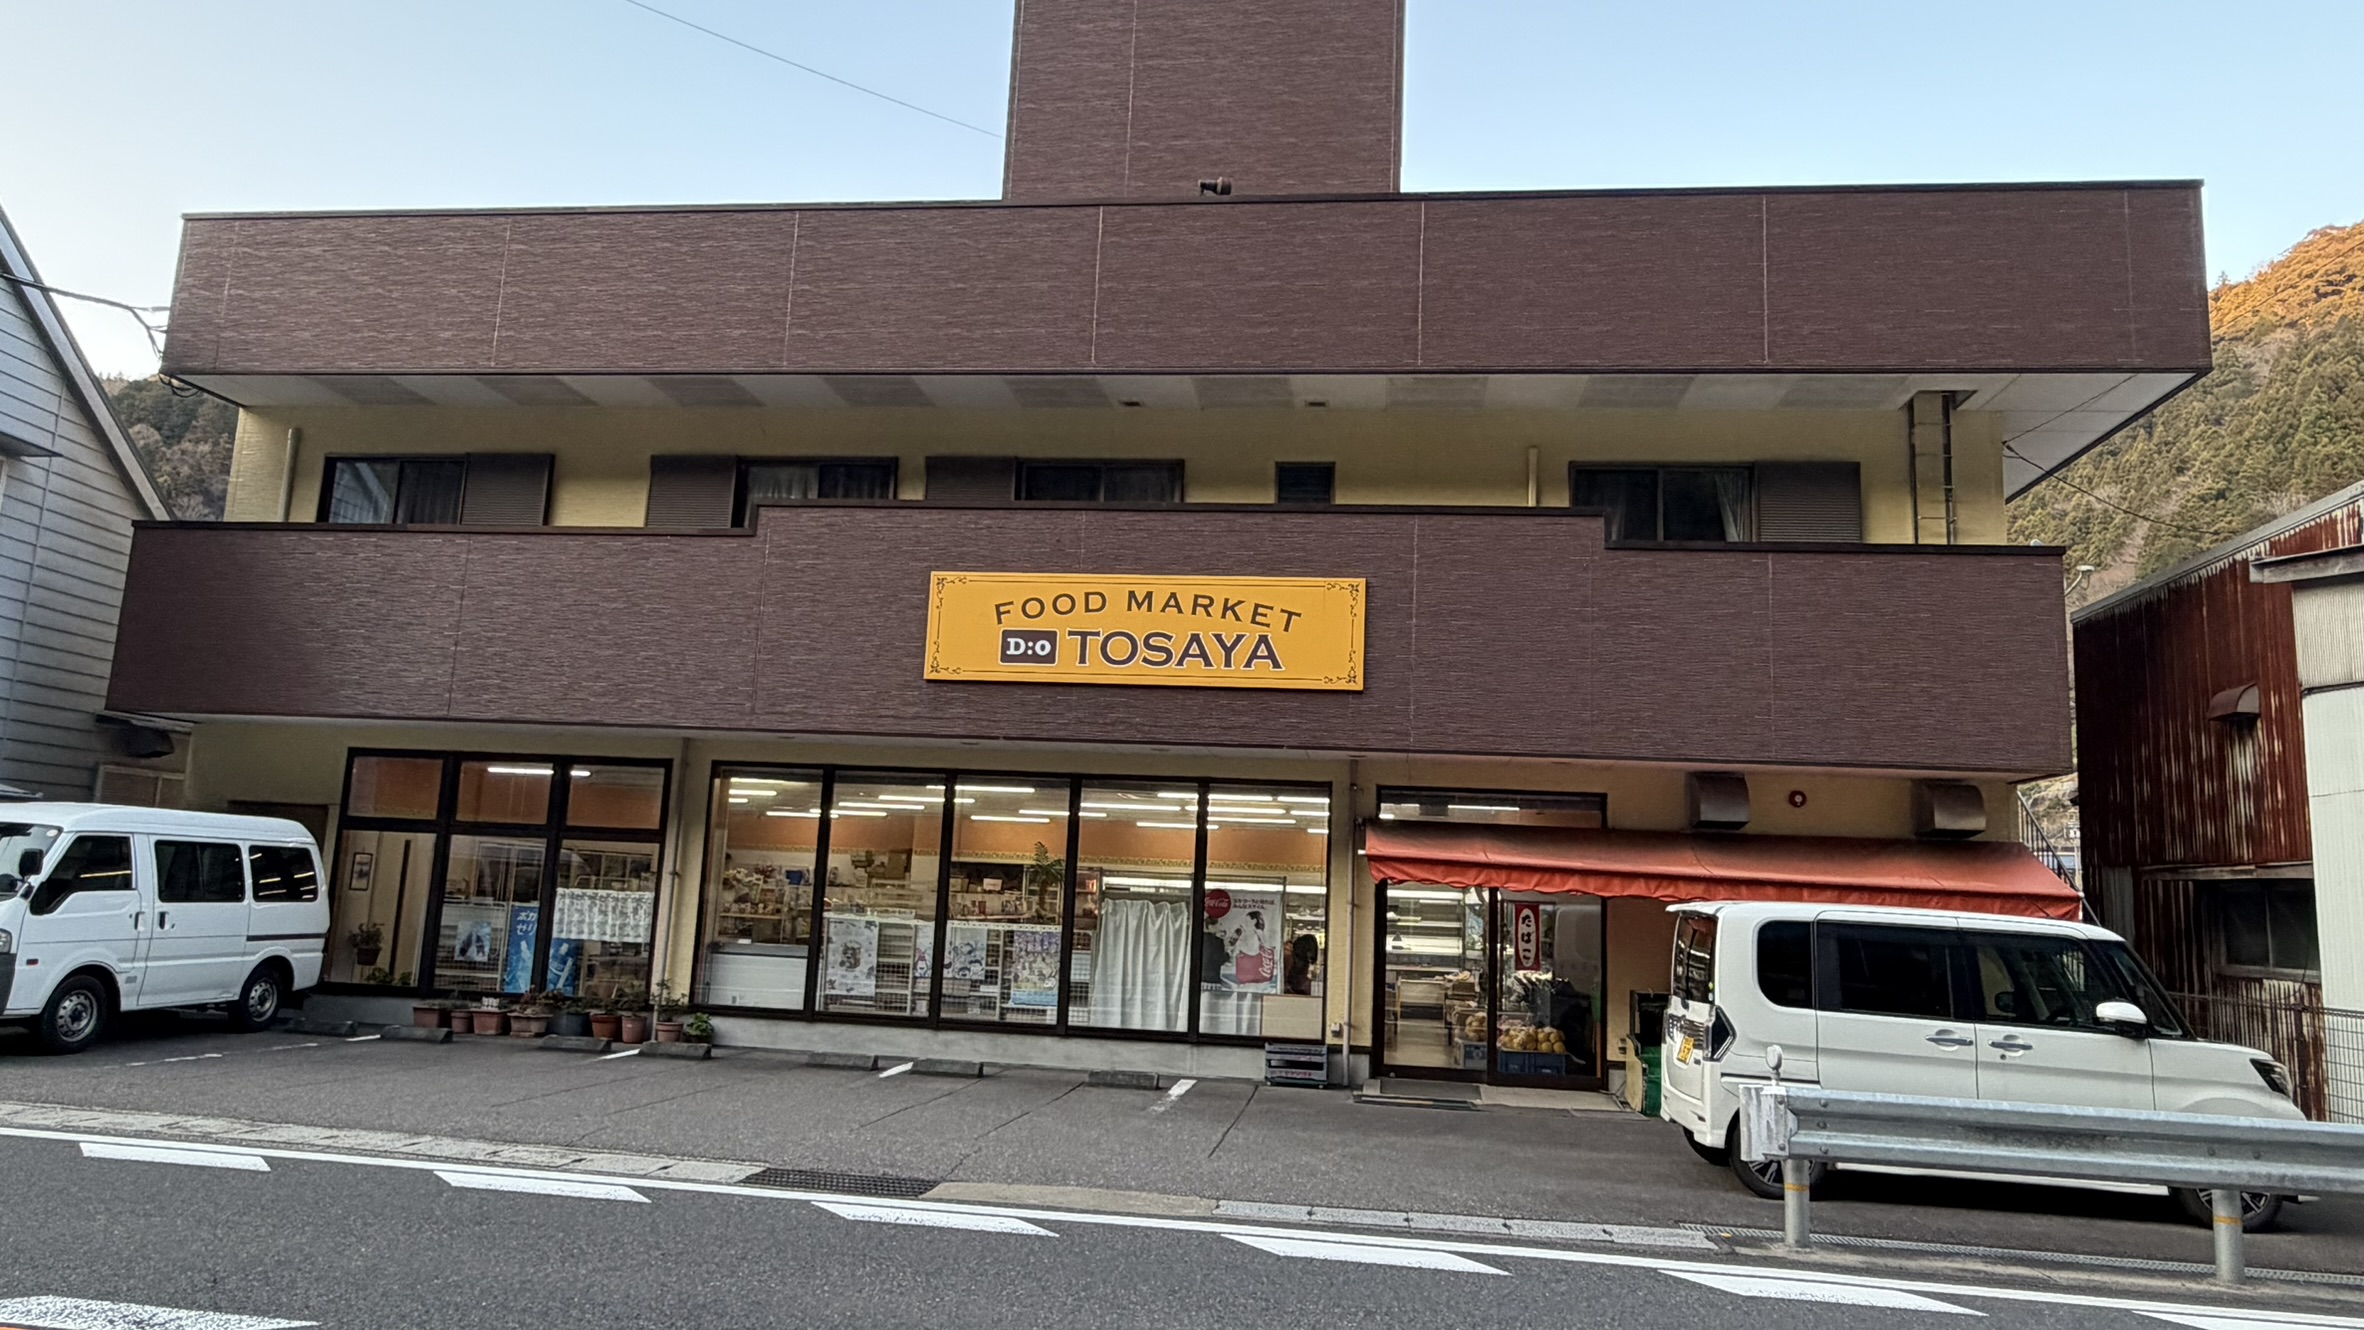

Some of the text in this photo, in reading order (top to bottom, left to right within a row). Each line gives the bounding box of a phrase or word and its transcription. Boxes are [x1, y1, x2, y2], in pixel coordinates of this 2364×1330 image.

[994, 590, 1302, 633] FOOD MARKET
[1067, 630, 1284, 670] TOSAYA
[1521, 914, 1534, 960] たばこ
